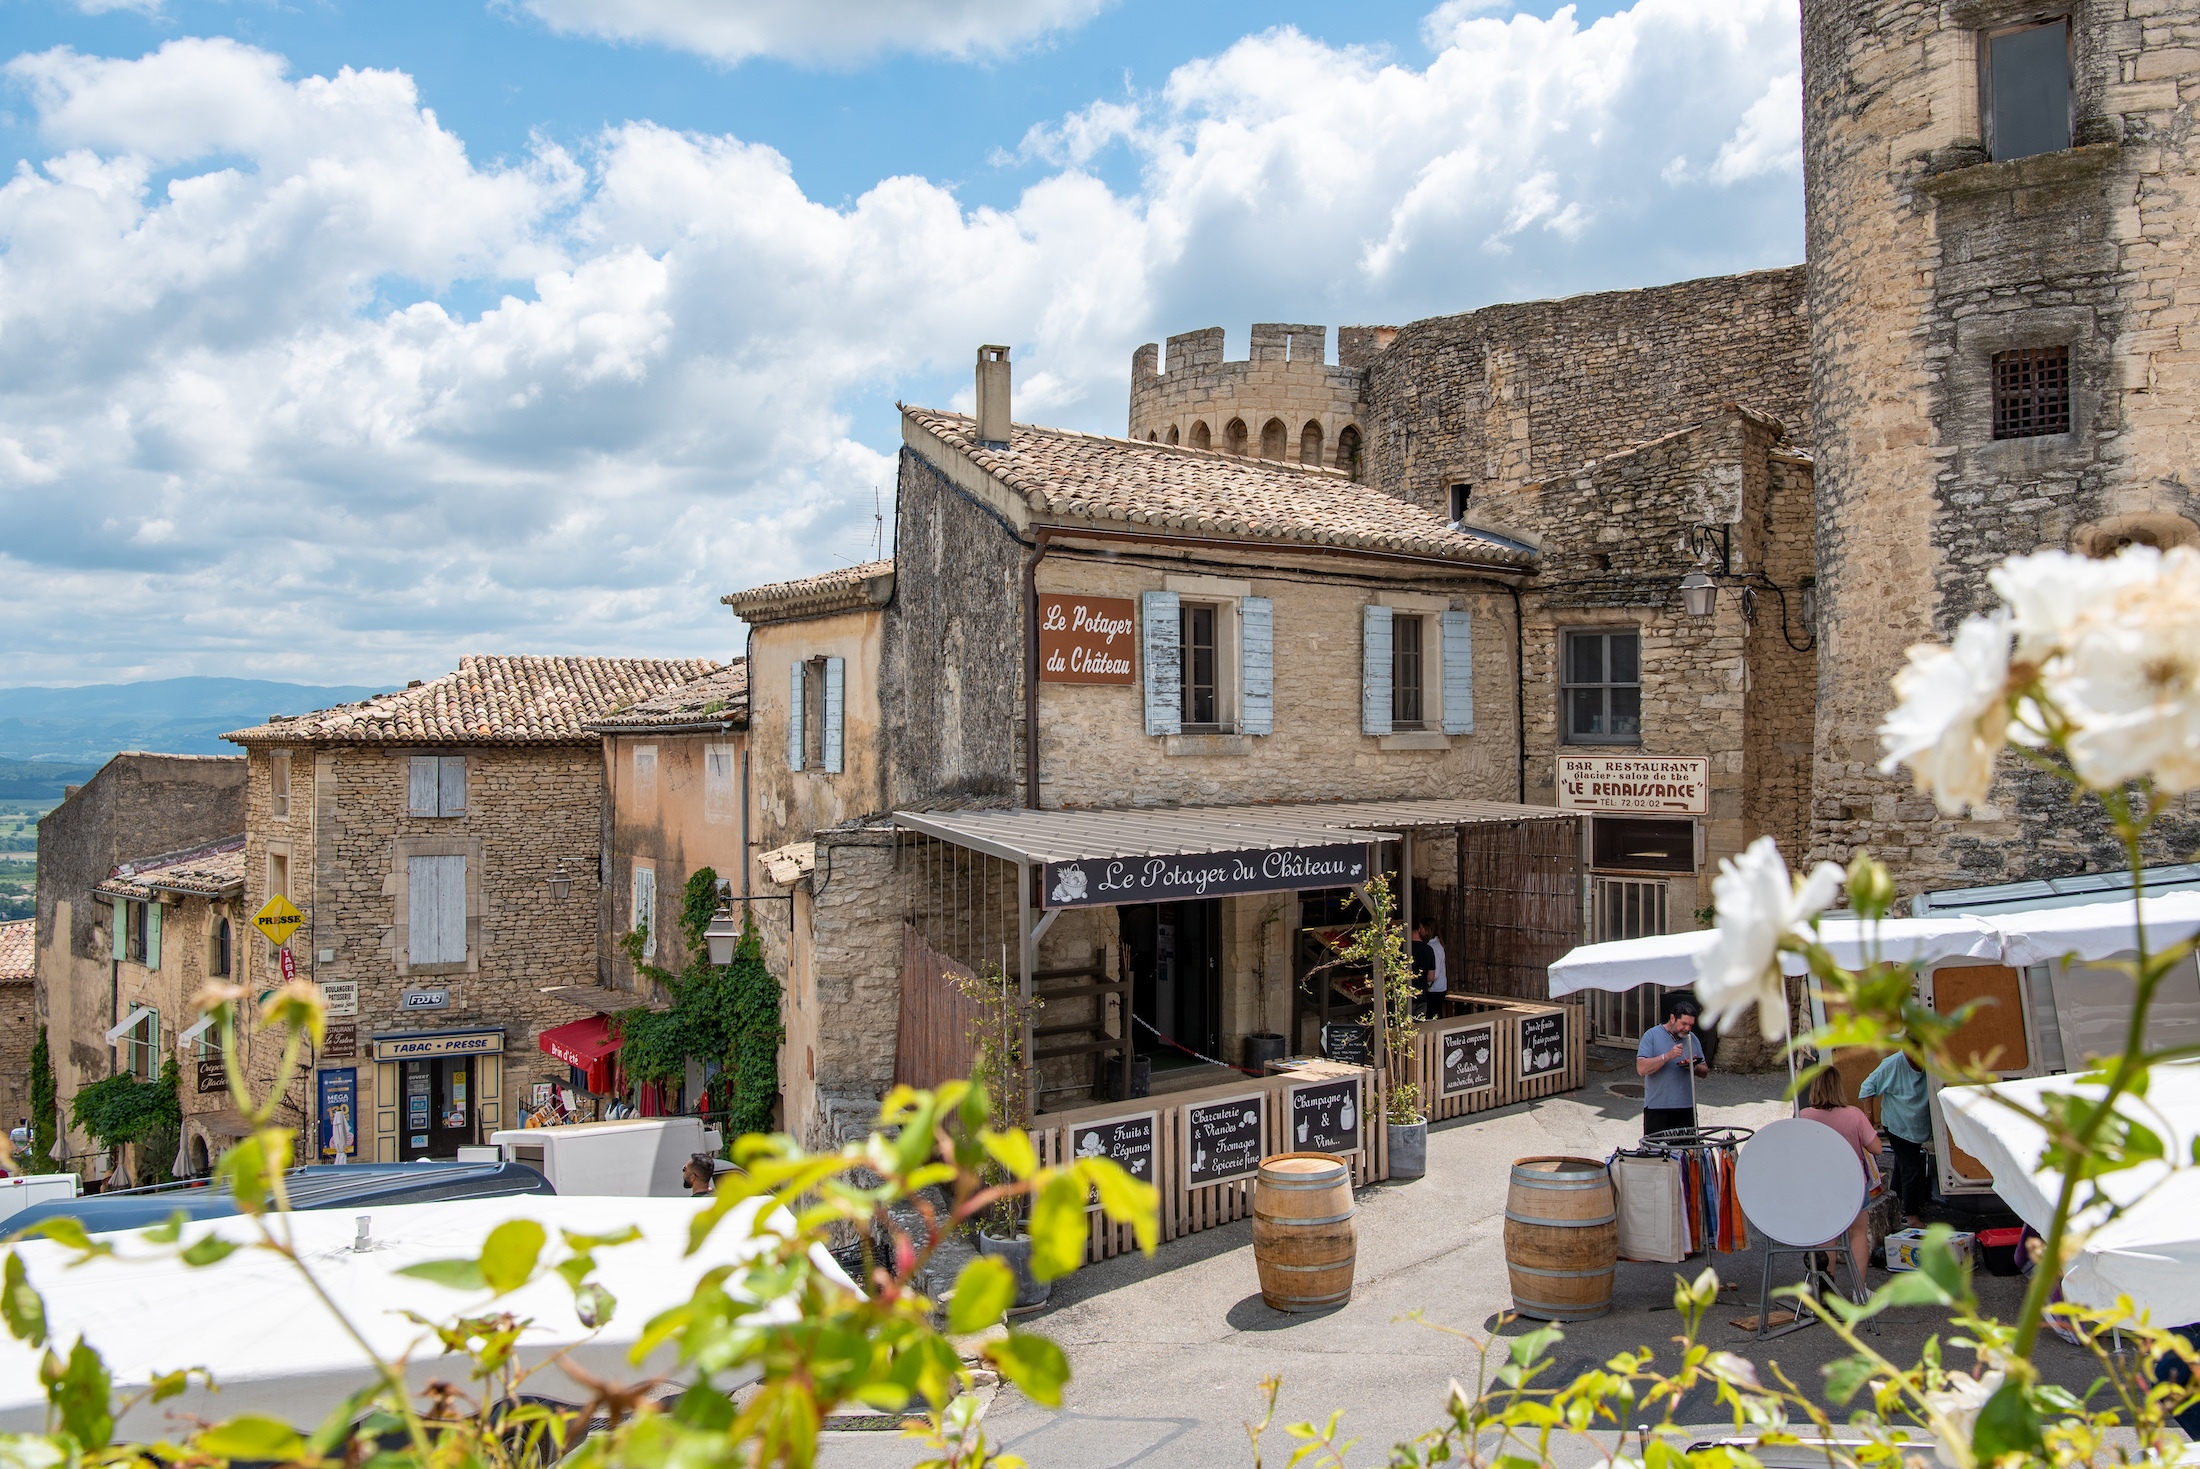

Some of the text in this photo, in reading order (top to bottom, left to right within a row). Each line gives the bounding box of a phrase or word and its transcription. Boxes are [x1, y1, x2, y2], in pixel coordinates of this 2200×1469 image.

[1042, 604, 1133, 645] Le Potager
[1046, 646, 1131, 675] du Château
[1566, 761, 1699, 772] BAR RESTAURANT
[1574, 770, 1689, 781] glacier salon de thé
[1621, 799, 1660, 808] 72/02/02
[1098, 851, 1347, 895] Le Potager du Château
[258, 915, 302, 925] PRESSE
[325, 985, 355, 994] BOULANGERIE
[410, 995, 431, 1005] FDJ
[393, 1039, 488, 1053] TABAC PRESSE
[1445, 1032, 1490, 1048] Vente à emporter
[551, 1043, 578, 1065] Brin d'été
[1294, 1094, 1341, 1111] Champagne
[1191, 1107, 1240, 1125] Charcuterie
[1321, 1112, 1330, 1127] &
[1113, 1124, 1150, 1141] Fruits &
[1194, 1121, 1237, 1139] & Viandes
[1110, 1142, 1151, 1161] Légumes
[1215, 1136, 1256, 1154] Fromages
[1211, 1151, 1260, 1176] Epicerie fine
